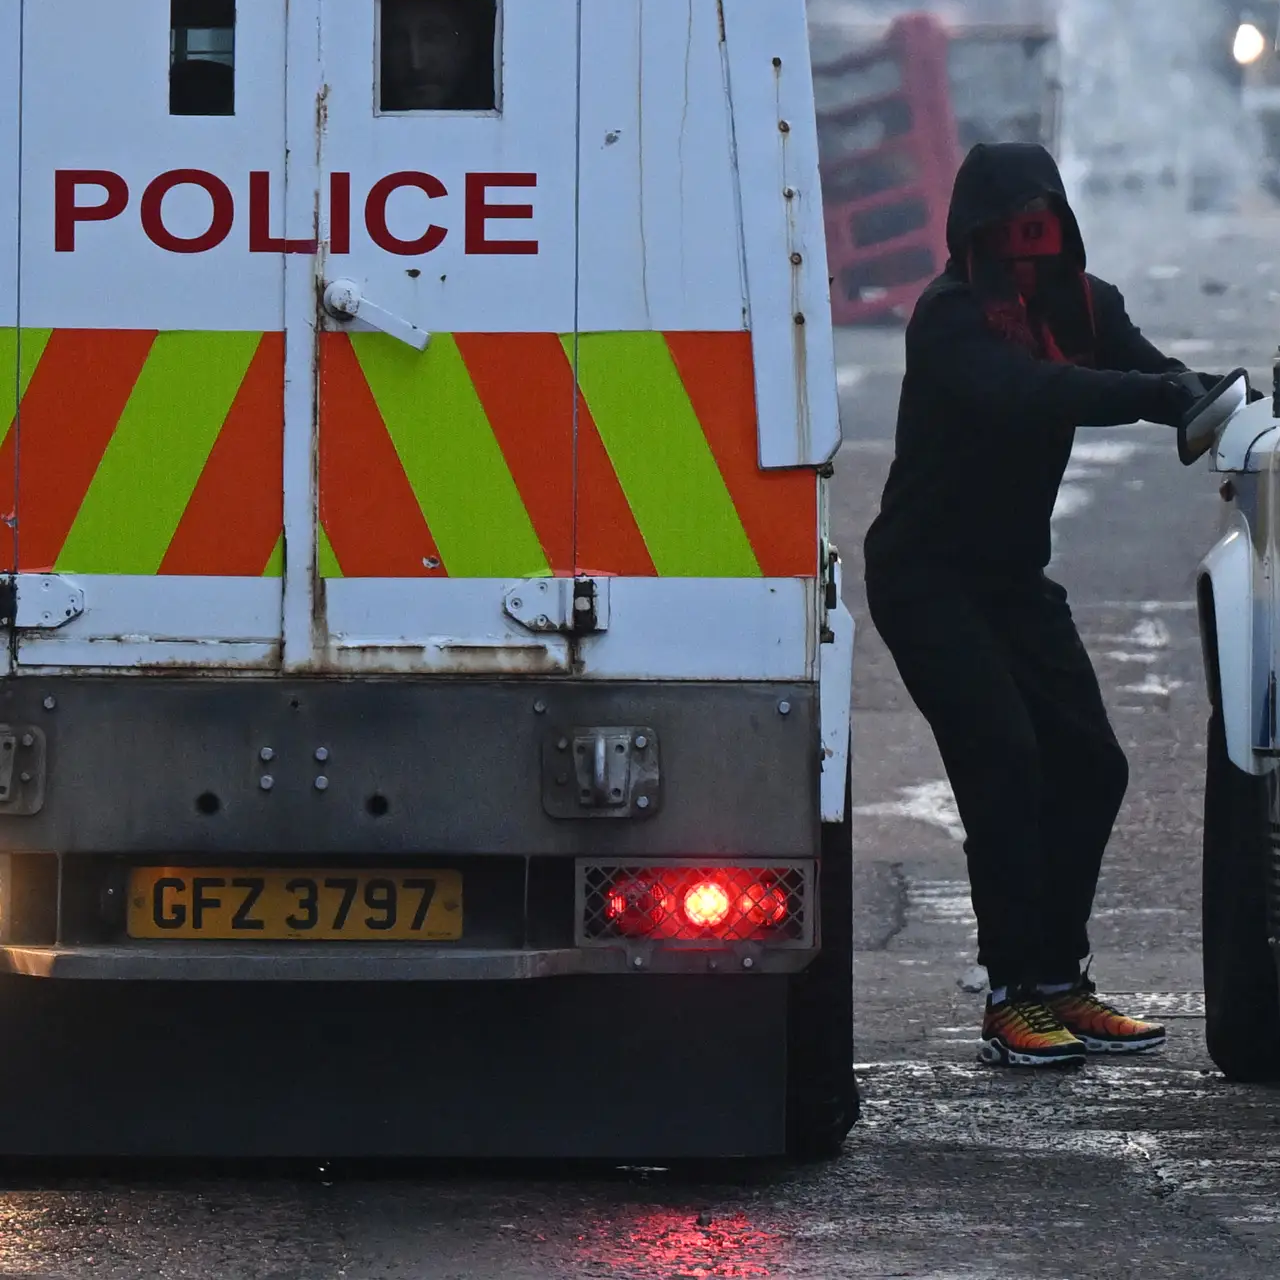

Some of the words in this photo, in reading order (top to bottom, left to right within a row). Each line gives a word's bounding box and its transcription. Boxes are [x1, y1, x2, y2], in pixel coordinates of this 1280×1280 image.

[54, 168, 538, 255] POLICE
[153, 877, 265, 930] GFZ
[285, 878, 436, 931] 3797
